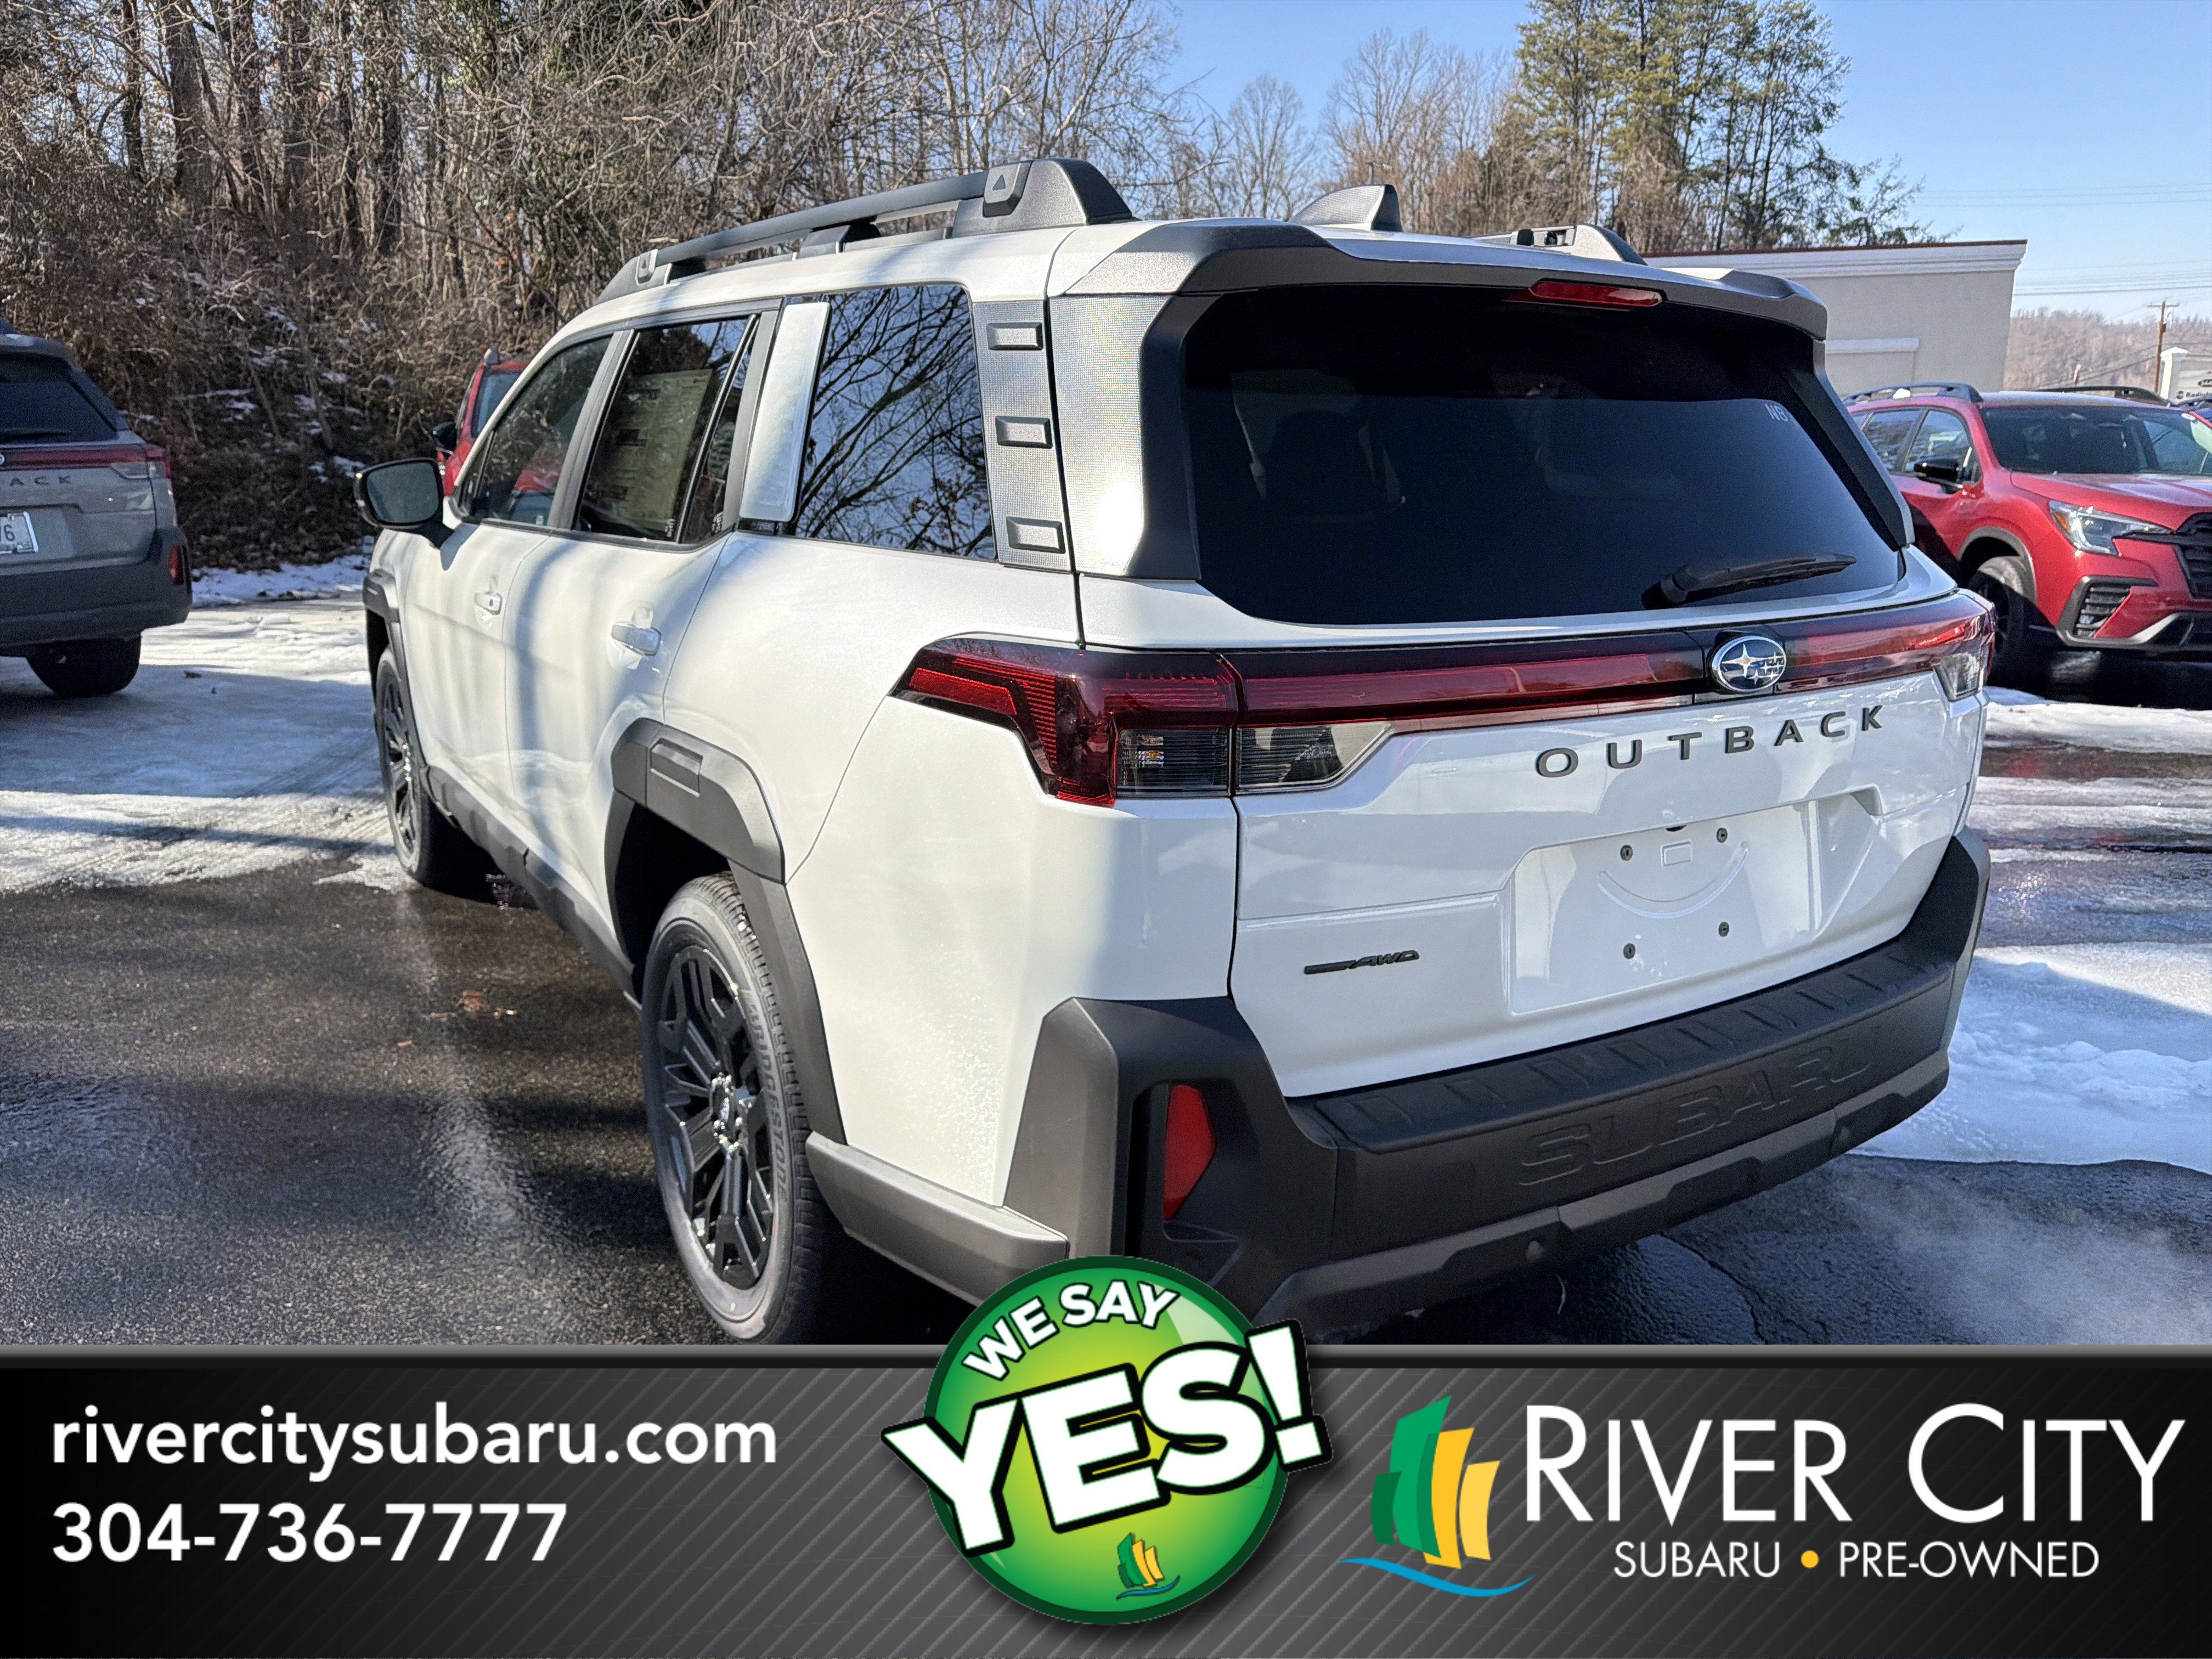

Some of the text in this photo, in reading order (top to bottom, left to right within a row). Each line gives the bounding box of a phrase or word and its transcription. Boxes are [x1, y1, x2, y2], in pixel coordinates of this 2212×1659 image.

[0, 524, 15, 541] 6
[1535, 705, 1884, 778] OUTBACK
[1348, 950, 1420, 969] AWD
[748, 1003, 788, 1200] BRIDGESTONE
[1519, 1026, 1880, 1186] SUBARU
